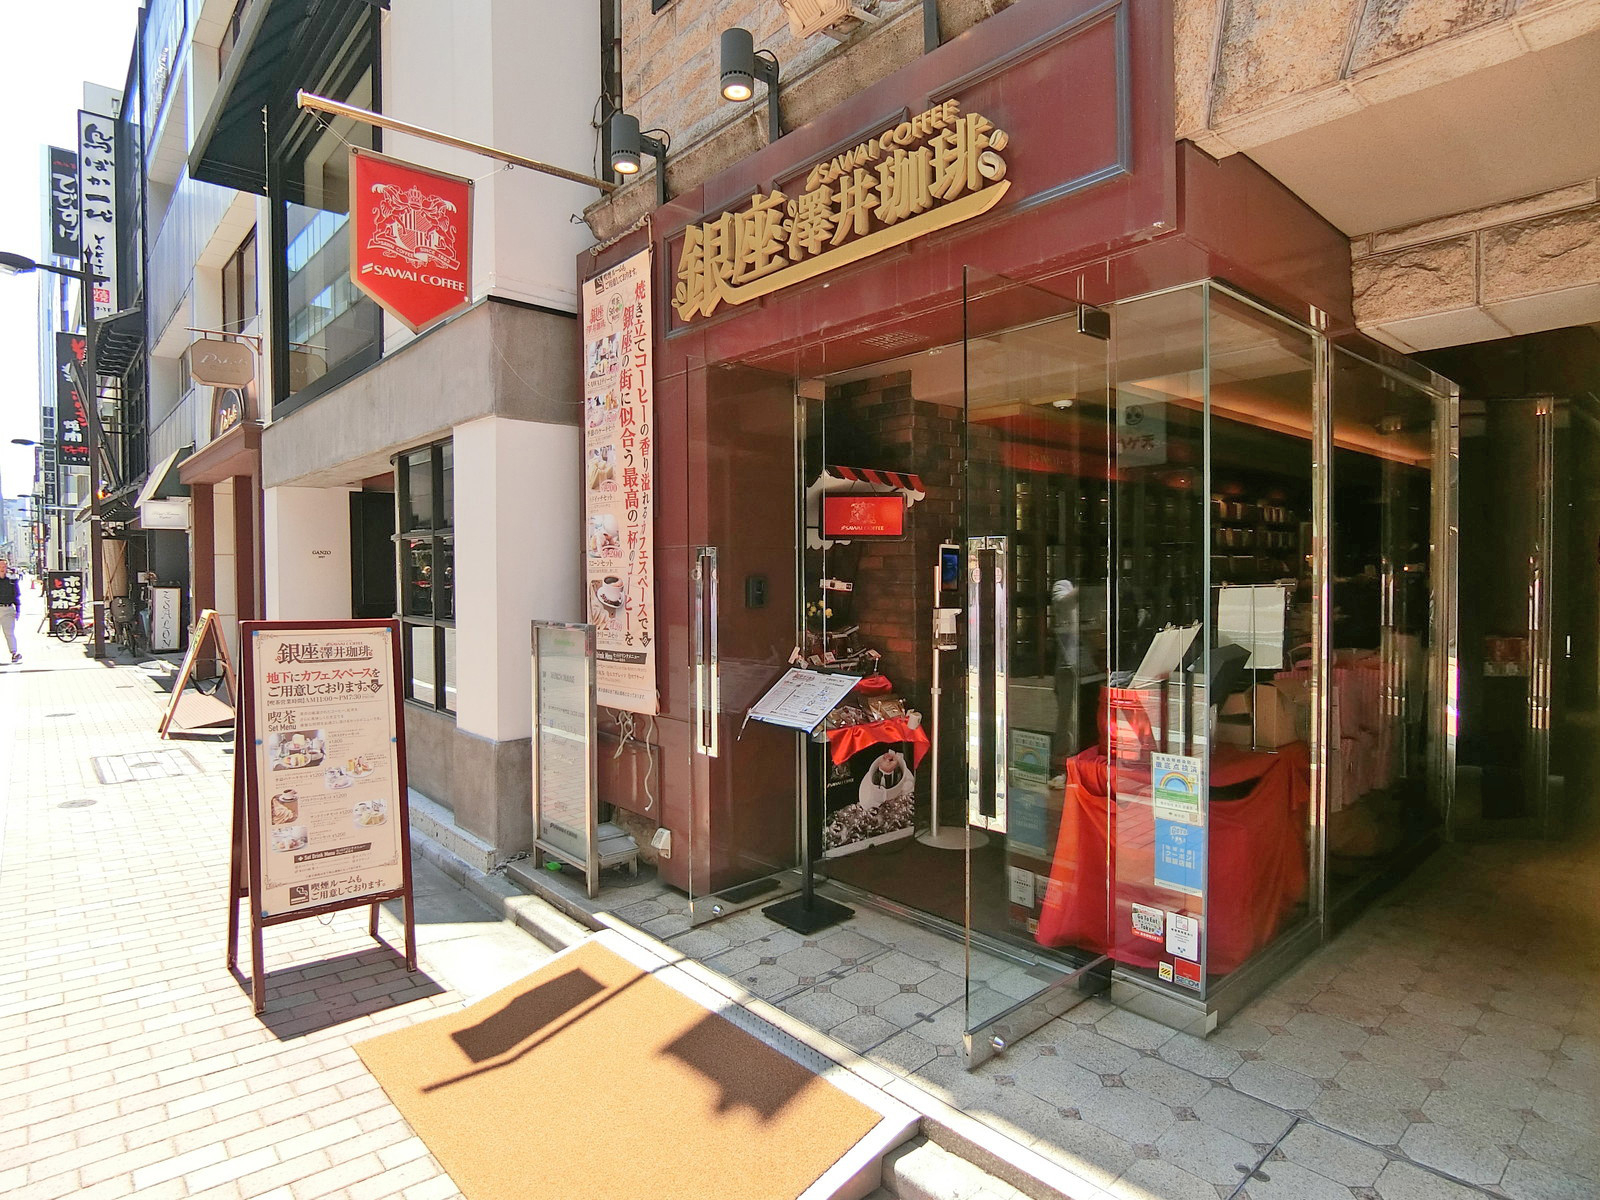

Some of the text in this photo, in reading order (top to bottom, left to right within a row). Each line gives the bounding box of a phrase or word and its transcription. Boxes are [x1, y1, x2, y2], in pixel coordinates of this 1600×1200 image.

[819, 99, 961, 184] SAWAI COFFEE
[677, 112, 996, 322] 銀座澤井珈琲
[373, 265, 465, 292] SAWAI COFFEE
[278, 643, 370, 664] 銀座澤井珈琲
[266, 667, 380, 684] 地下にカフェスペースを
[268, 681, 369, 698] ご用意しております。
[268, 711, 297, 725] 喫茶
[268, 723, 297, 732] Set Menu
[311, 875, 363, 891] 喫煙ルームも
[311, 880, 386, 901] ご用意しております。
